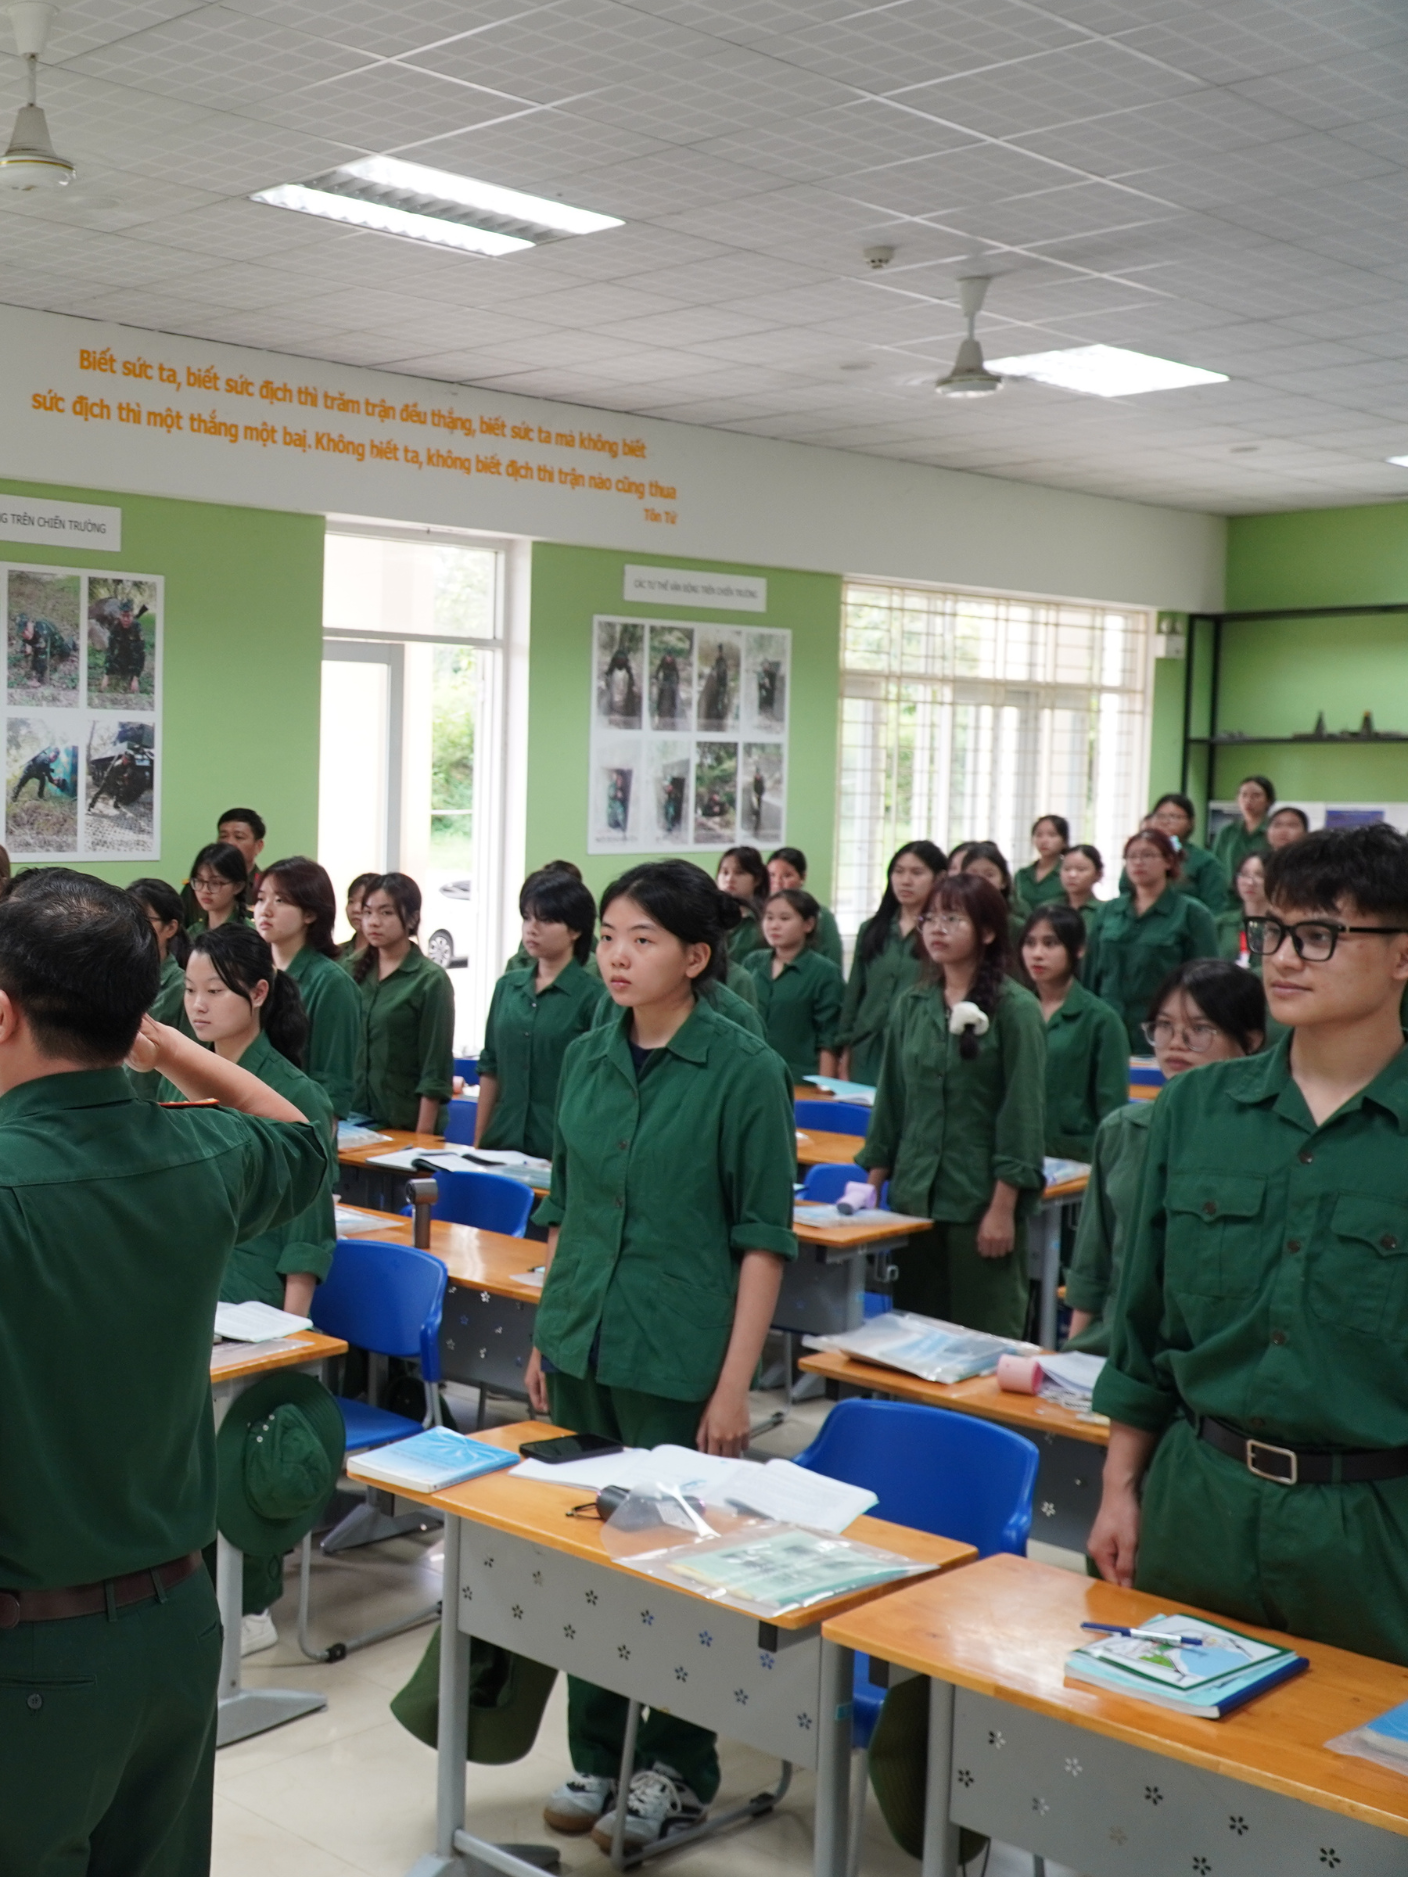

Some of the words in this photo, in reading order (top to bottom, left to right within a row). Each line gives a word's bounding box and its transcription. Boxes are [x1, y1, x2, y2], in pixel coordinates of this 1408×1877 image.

[32, 389, 65, 413] sức
[72, 395, 111, 421] địch
[117, 402, 142, 424] thì
[146, 408, 183, 433] một
[189, 410, 239, 443] thắng
[243, 422, 278, 447] một
[315, 432, 365, 462] Không
[370, 440, 399, 461] biết
[403, 446, 423, 468] ta,
[426, 448, 471, 475] không
[475, 455, 502, 475] biết
[505, 460, 534, 481] địch
[557, 468, 585, 489] trận
[615, 477, 645, 499] cũng
[648, 481, 677, 499] thua
[79, 348, 117, 374] Biết
[122, 357, 153, 380] sức
[157, 363, 182, 391] ta,
[186, 365, 220, 391] biết
[225, 375, 254, 397] sức
[259, 380, 293, 404] địch
[297, 386, 318, 407] thì
[323, 391, 361, 414] trăm
[364, 398, 396, 423] trận
[479, 416, 507, 437] biết
[537, 427, 552, 444] ta
[578, 432, 619, 458] không
[11, 512, 35, 526] TRÊN
[37, 515, 65, 530] CHIẾN
[68, 518, 107, 534] TRƯỜNG
